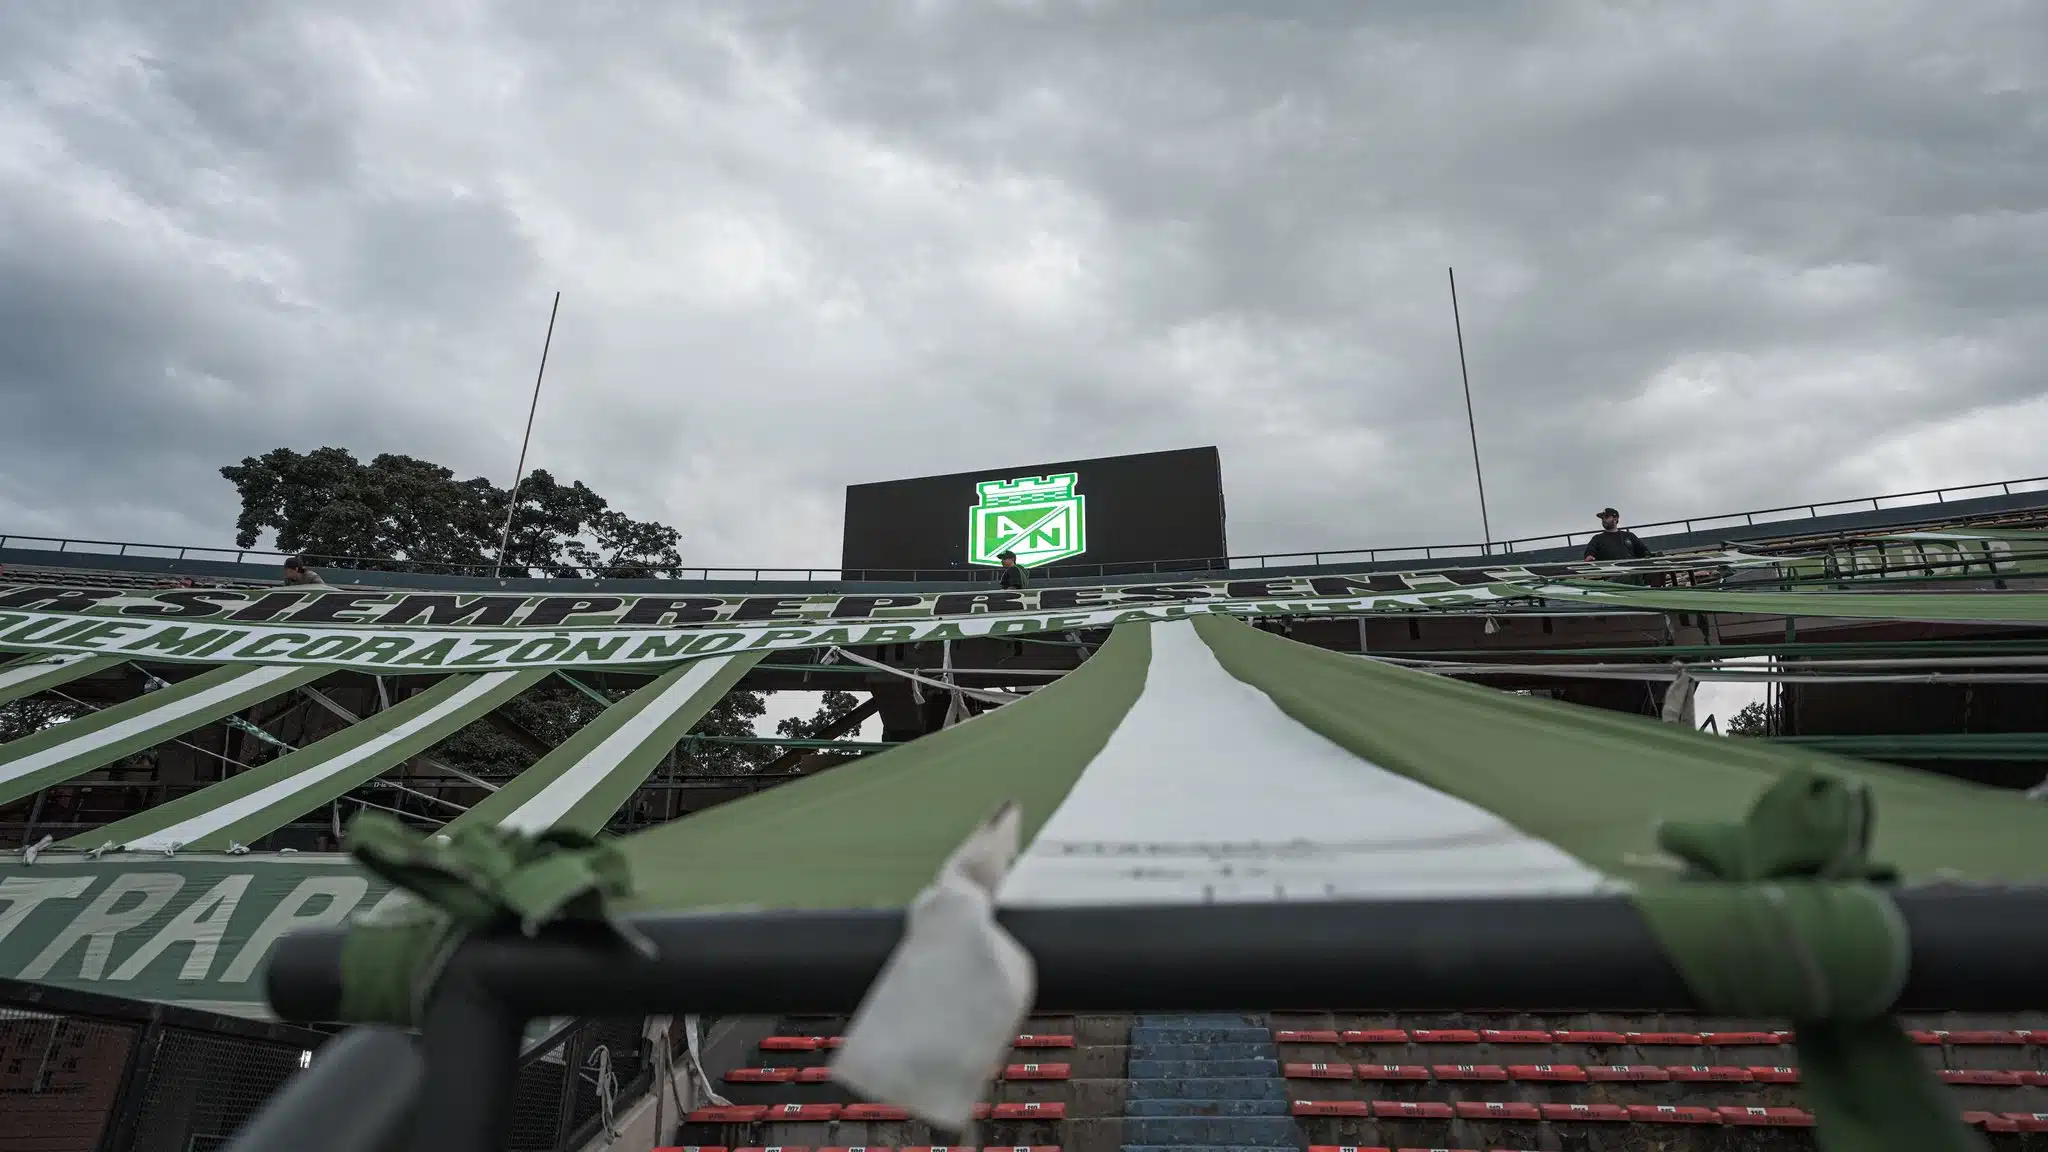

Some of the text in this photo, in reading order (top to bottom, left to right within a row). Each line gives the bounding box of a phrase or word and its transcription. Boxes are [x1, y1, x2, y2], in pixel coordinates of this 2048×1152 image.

[119, 588, 809, 626] SIEMPRE
[118, 626, 252, 658] MI
[625, 632, 747, 660] NO
[750, 622, 966, 649] PARA
